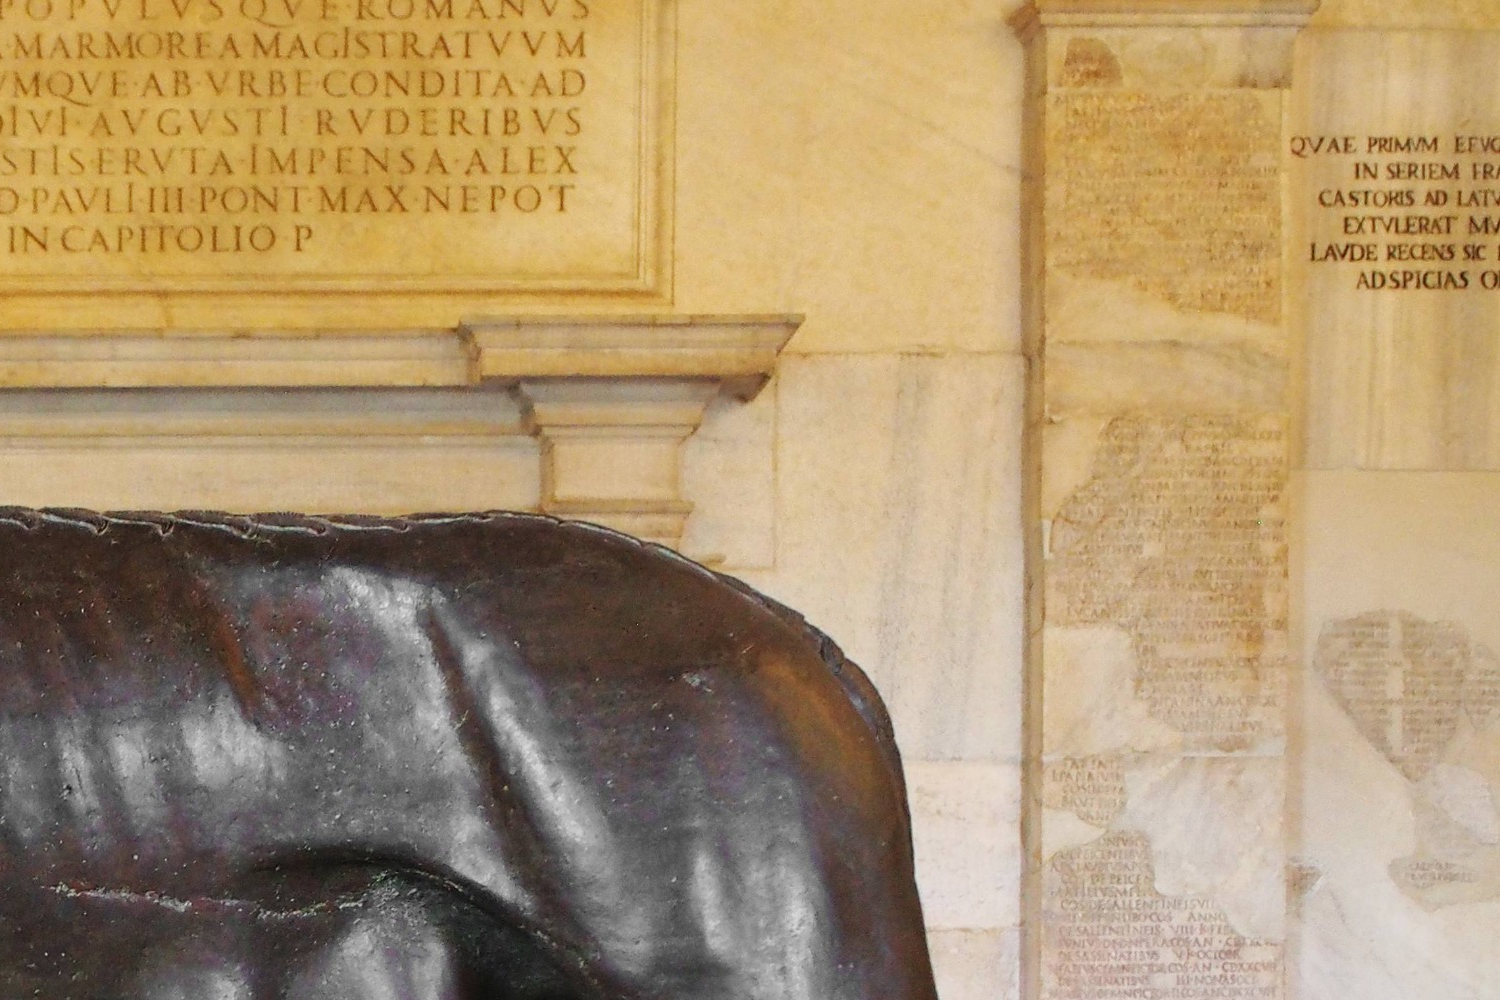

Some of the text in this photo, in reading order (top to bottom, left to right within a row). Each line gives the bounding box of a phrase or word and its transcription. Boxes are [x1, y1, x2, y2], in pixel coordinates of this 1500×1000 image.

[13, 31, 242, 59] MARMOREA
[252, 27, 587, 59] MAGISTRATVVM
[141, 69, 192, 97] AB
[204, 69, 313, 97] VRBE
[322, 69, 515, 97] CONDITA
[530, 69, 586, 97] AD
[88, 104, 289, 137] AVGVSTI
[315, 107, 582, 137] RVDERIBVS
[1290, 135, 1357, 158] QVAE
[1367, 135, 1439, 154] PRIMVM
[97, 147, 235, 176] ERVTA
[249, 143, 450, 176] IMPENSA
[463, 146, 579, 175] ALEX
[1354, 162, 1379, 181] IN
[1387, 162, 1461, 181] SERIEM
[31, 182, 136, 214] PAVLI
[147, 186, 184, 214] III
[199, 186, 308, 214] PONT
[318, 185, 409, 214] MAX
[422, 184, 576, 214] NEPOT
[1318, 189, 1415, 208] CASTORIS
[1423, 189, 1449, 208] AD
[1343, 215, 1460, 235] EXTVLERAT
[7, 224, 313, 253] IN CAPITOLIO P
[1310, 243, 1487, 263] LAVDE RECENS SIC
[1356, 269, 1470, 292] ADSPICIAS
